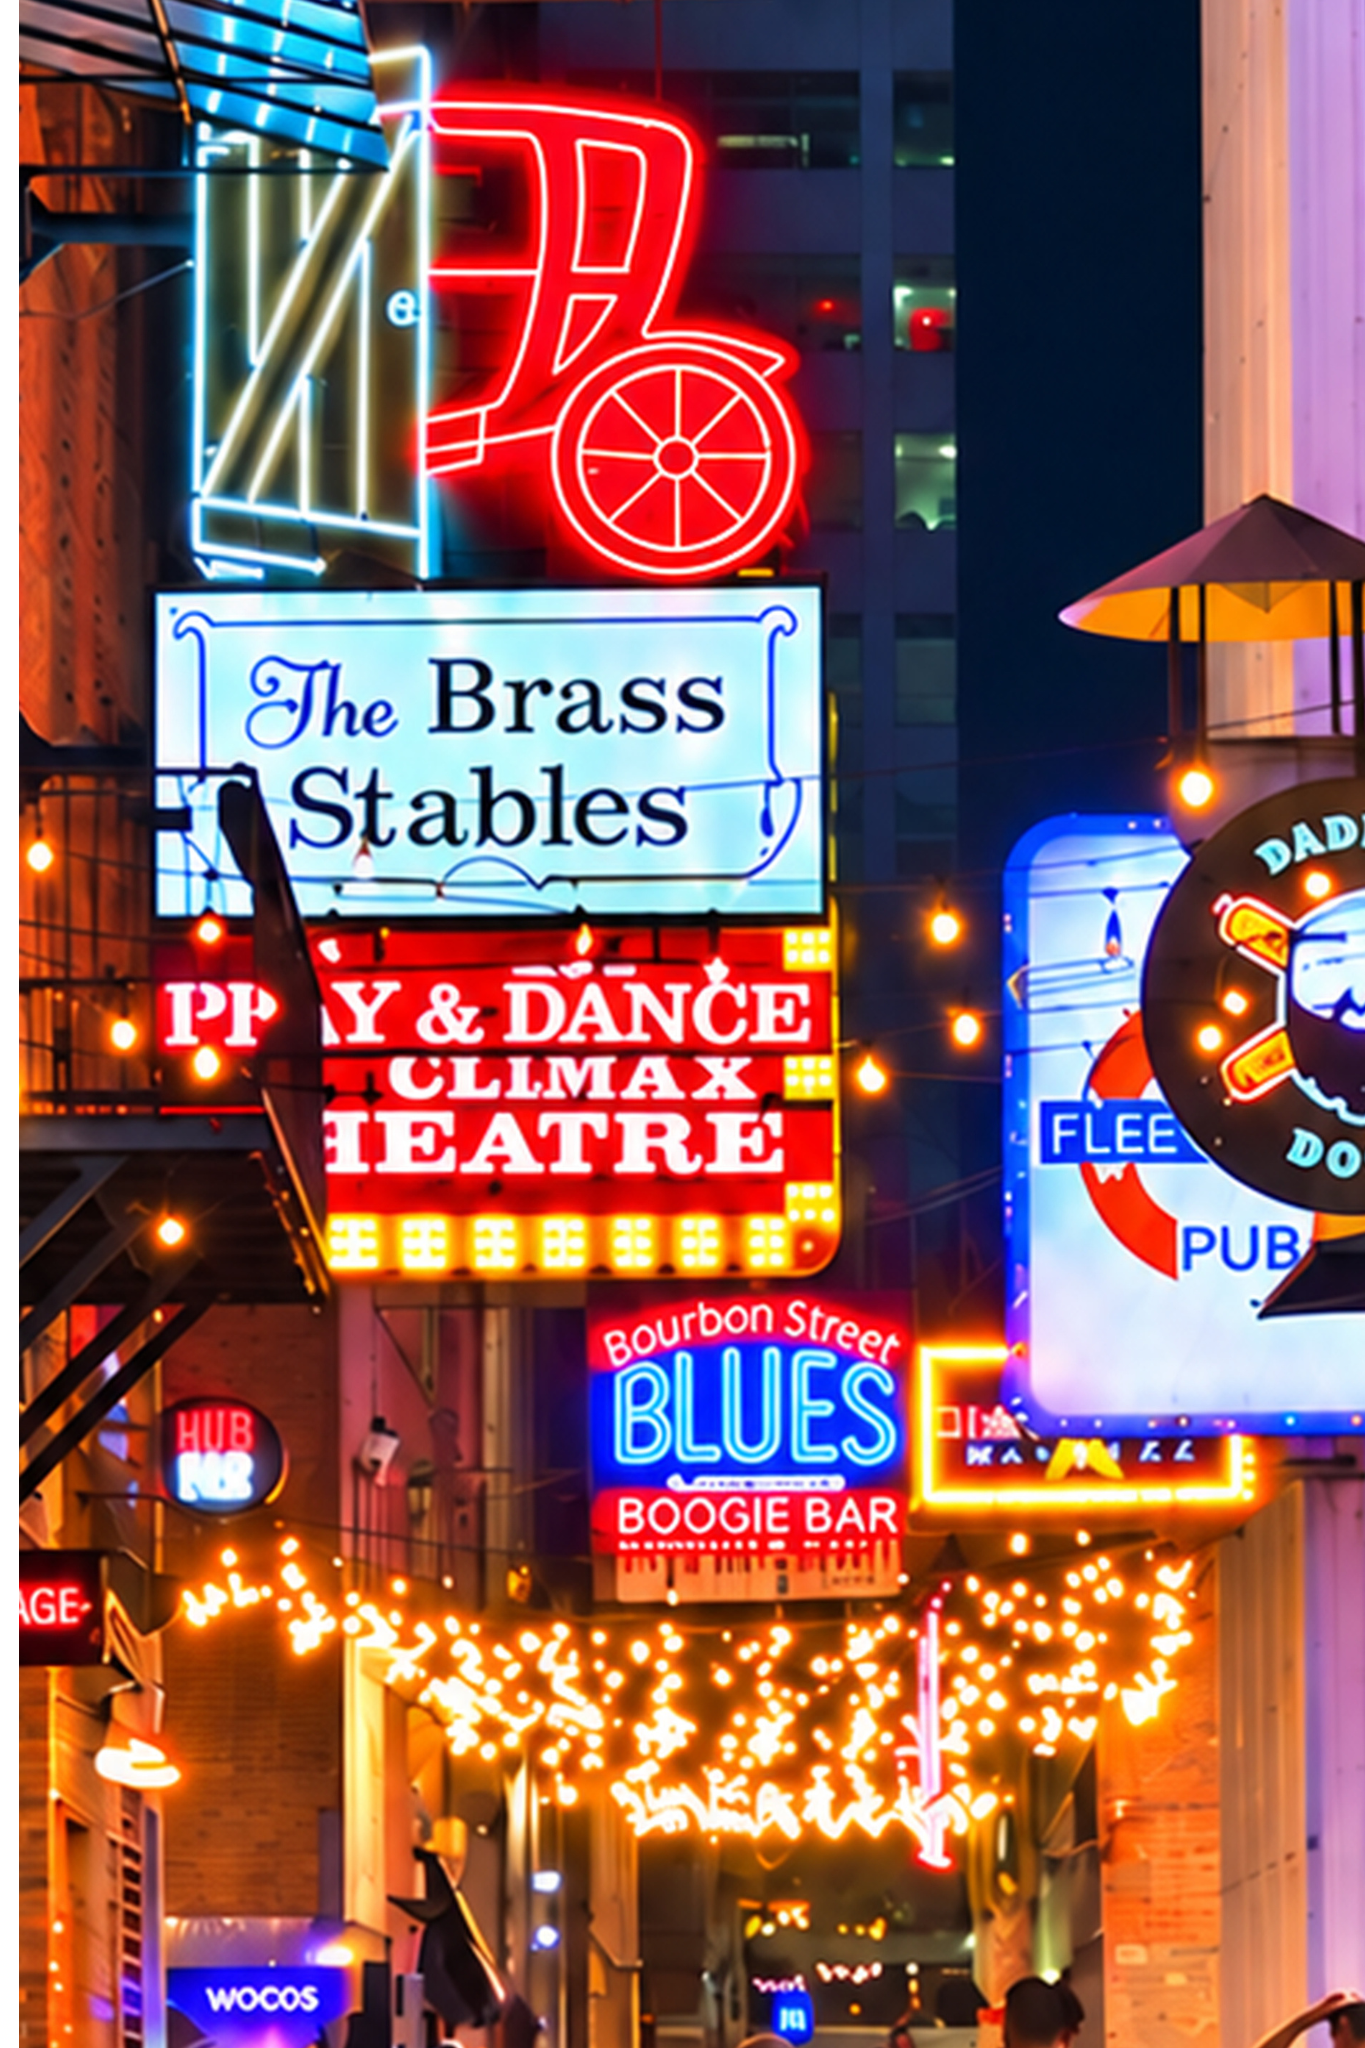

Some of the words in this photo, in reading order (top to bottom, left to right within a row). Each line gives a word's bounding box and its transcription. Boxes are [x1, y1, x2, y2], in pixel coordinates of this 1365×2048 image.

[245, 655, 399, 749] The
[428, 657, 726, 734] Brass
[288, 765, 689, 849] Stables
[1253, 813, 1365, 877] DAD
[415, 982, 485, 1044] &
[502, 981, 811, 1045] DANCE
[387, 1056, 758, 1101] CLIMAX
[1050, 1113, 1178, 1156] FLEE
[1285, 1126, 1365, 1179] DO
[1181, 1226, 1301, 1272] PUB
[603, 1301, 773, 1367] Bourbon
[784, 1300, 900, 1365] Street
[177, 1410, 255, 1452] HUB
[614, 1346, 897, 1466] BLUES
[617, 1496, 790, 1535] BOOGIE
[804, 1496, 899, 1535] BAR
